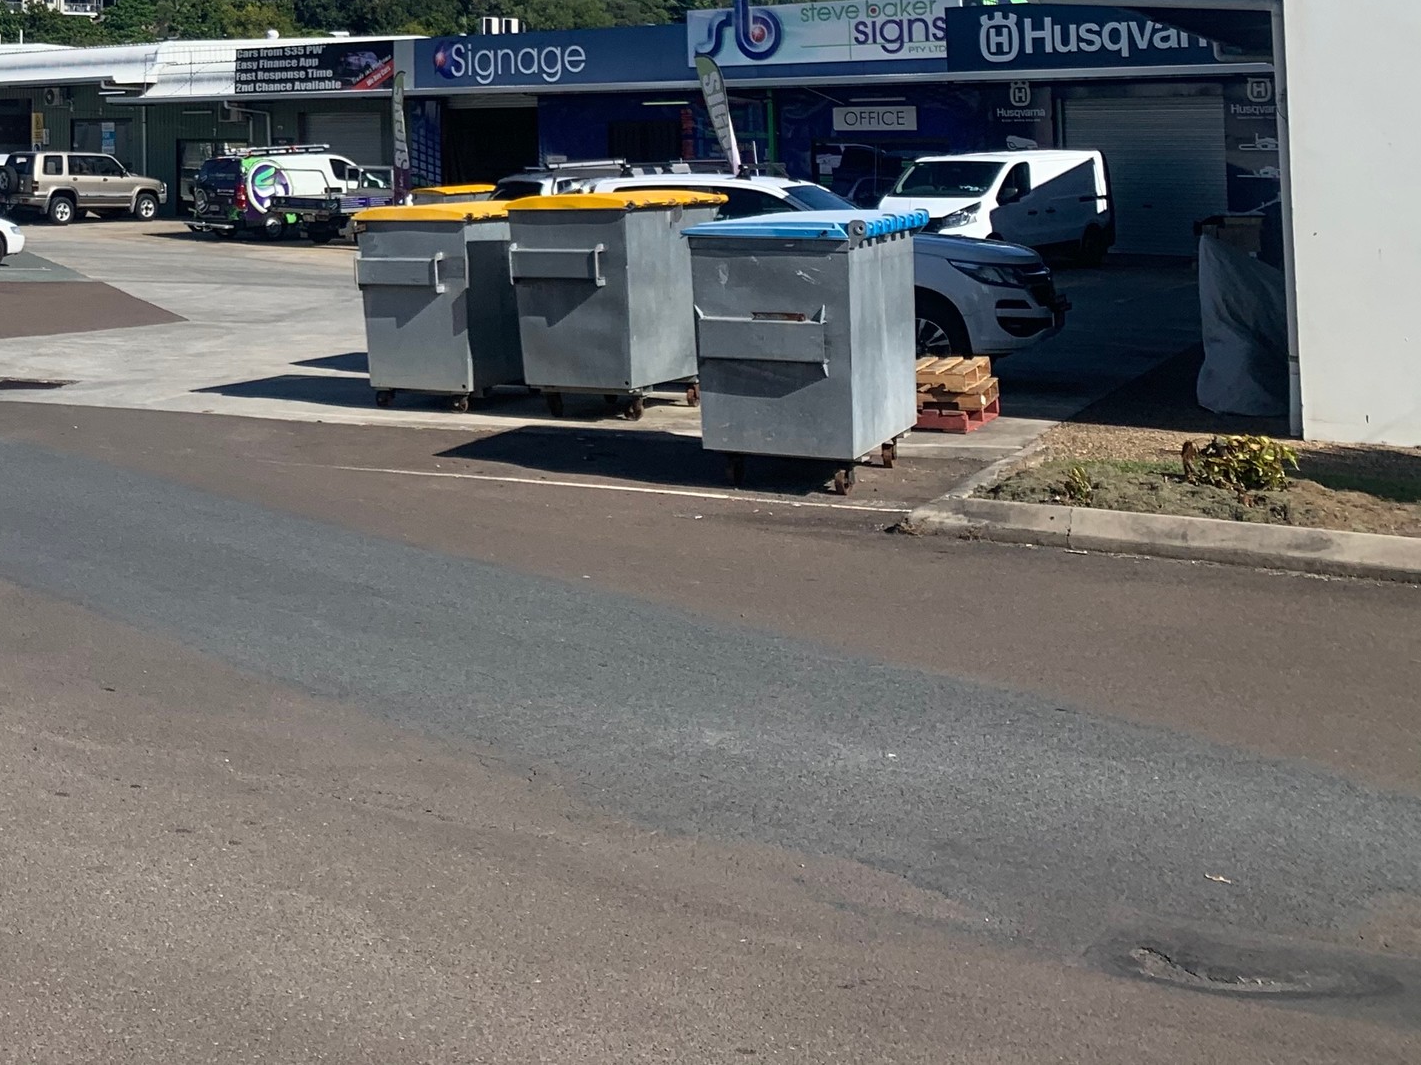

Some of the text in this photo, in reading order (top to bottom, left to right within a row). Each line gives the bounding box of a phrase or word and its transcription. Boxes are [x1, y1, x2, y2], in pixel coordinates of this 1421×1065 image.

[800, 3, 860, 23] steve
[853, 16, 947, 54] signs
[1024, 17, 1208, 57] Husqva
[236, 49, 259, 59] Cars
[260, 47, 283, 57] from
[284, 46, 305, 56] $35
[908, 44, 947, 53] PTY LTD
[236, 57, 319, 70] Easy Finance App
[451, 43, 586, 84] Signage
[236, 68, 333, 81] Fast Response Time
[236, 80, 342, 92] 2nd Chance Available
[702, 71, 735, 160] SIGN
[996, 107, 1046, 118] Husqvarna
[1230, 104, 1278, 115] Husqvar
[843, 110, 905, 126] OFFICE
